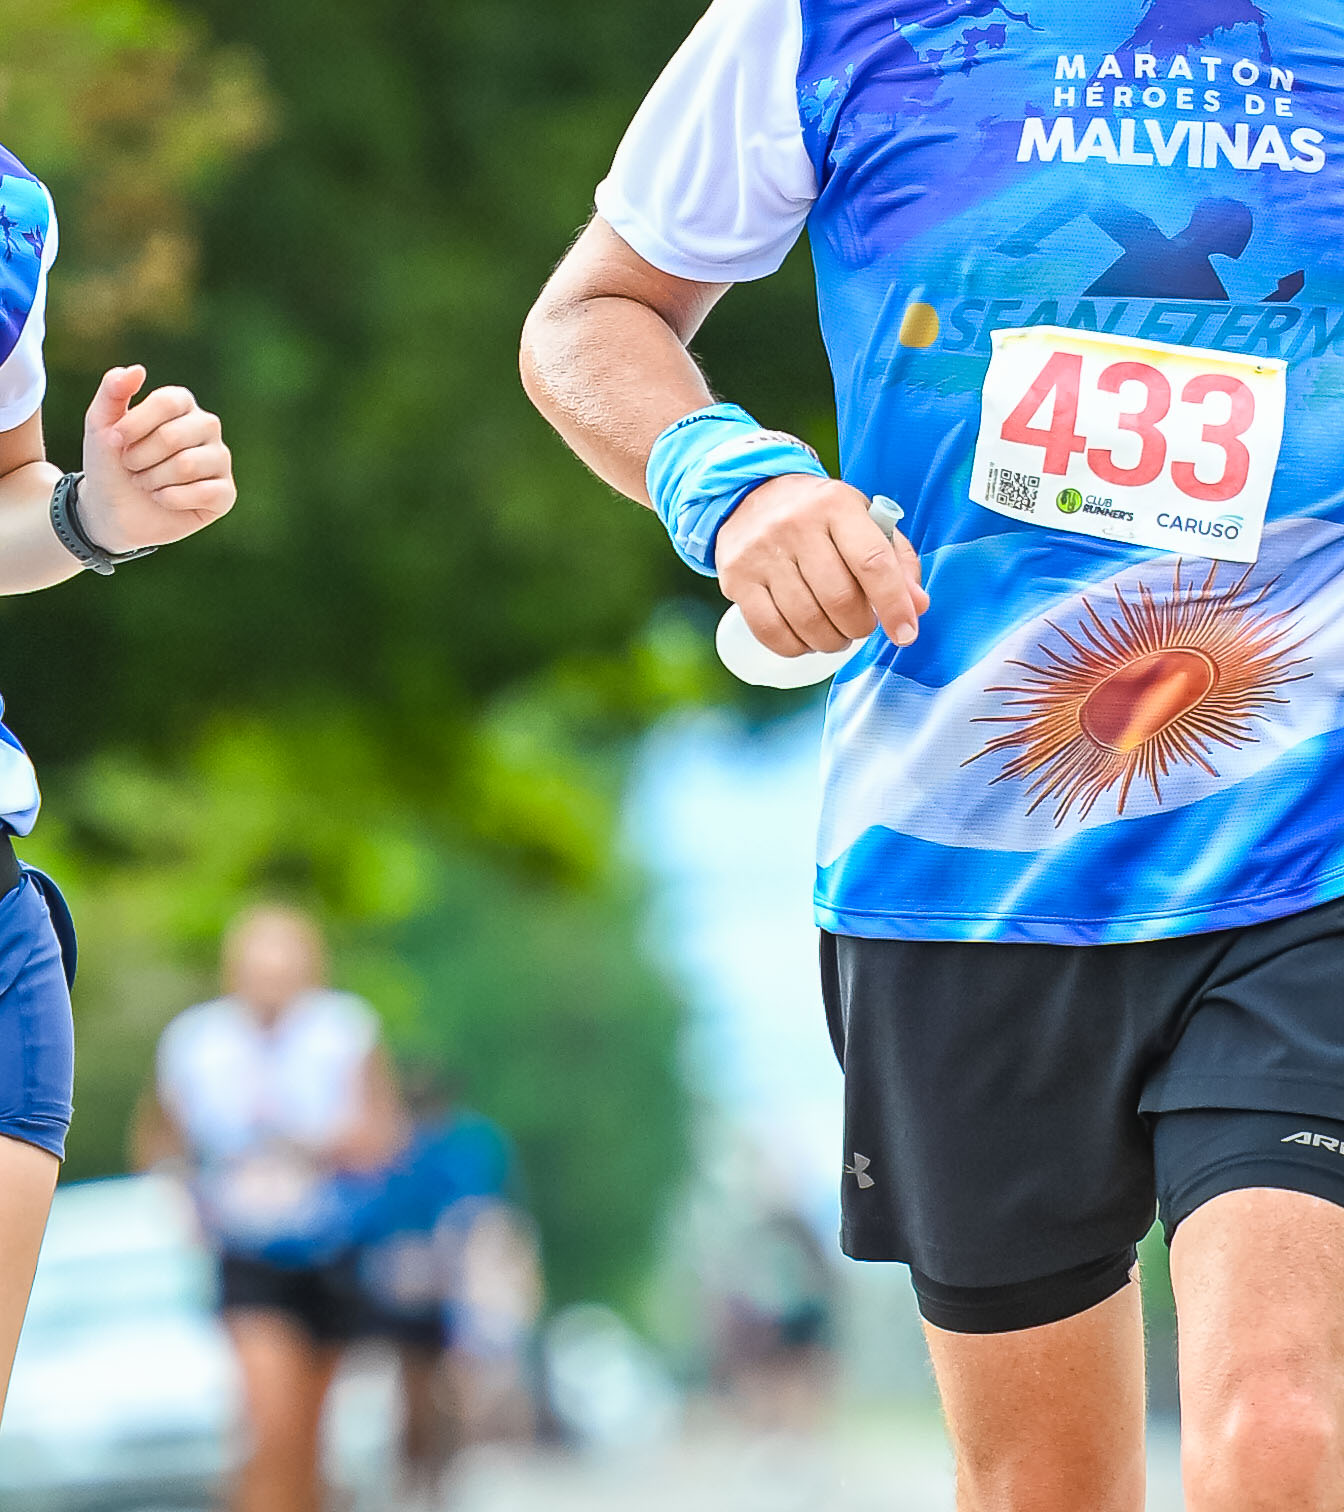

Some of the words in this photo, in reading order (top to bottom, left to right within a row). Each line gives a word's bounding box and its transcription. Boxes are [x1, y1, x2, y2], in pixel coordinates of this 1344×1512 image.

[1055, 53, 1294, 92] MARATÓN
[1054, 82, 1221, 113] HÉROES
[1244, 93, 1294, 117] DE
[1016, 116, 1326, 174] MALVINAS
[1000, 351, 1255, 502] 433
[1085, 494, 1113, 507] CLUB
[1156, 512, 1239, 541] CARUSO
